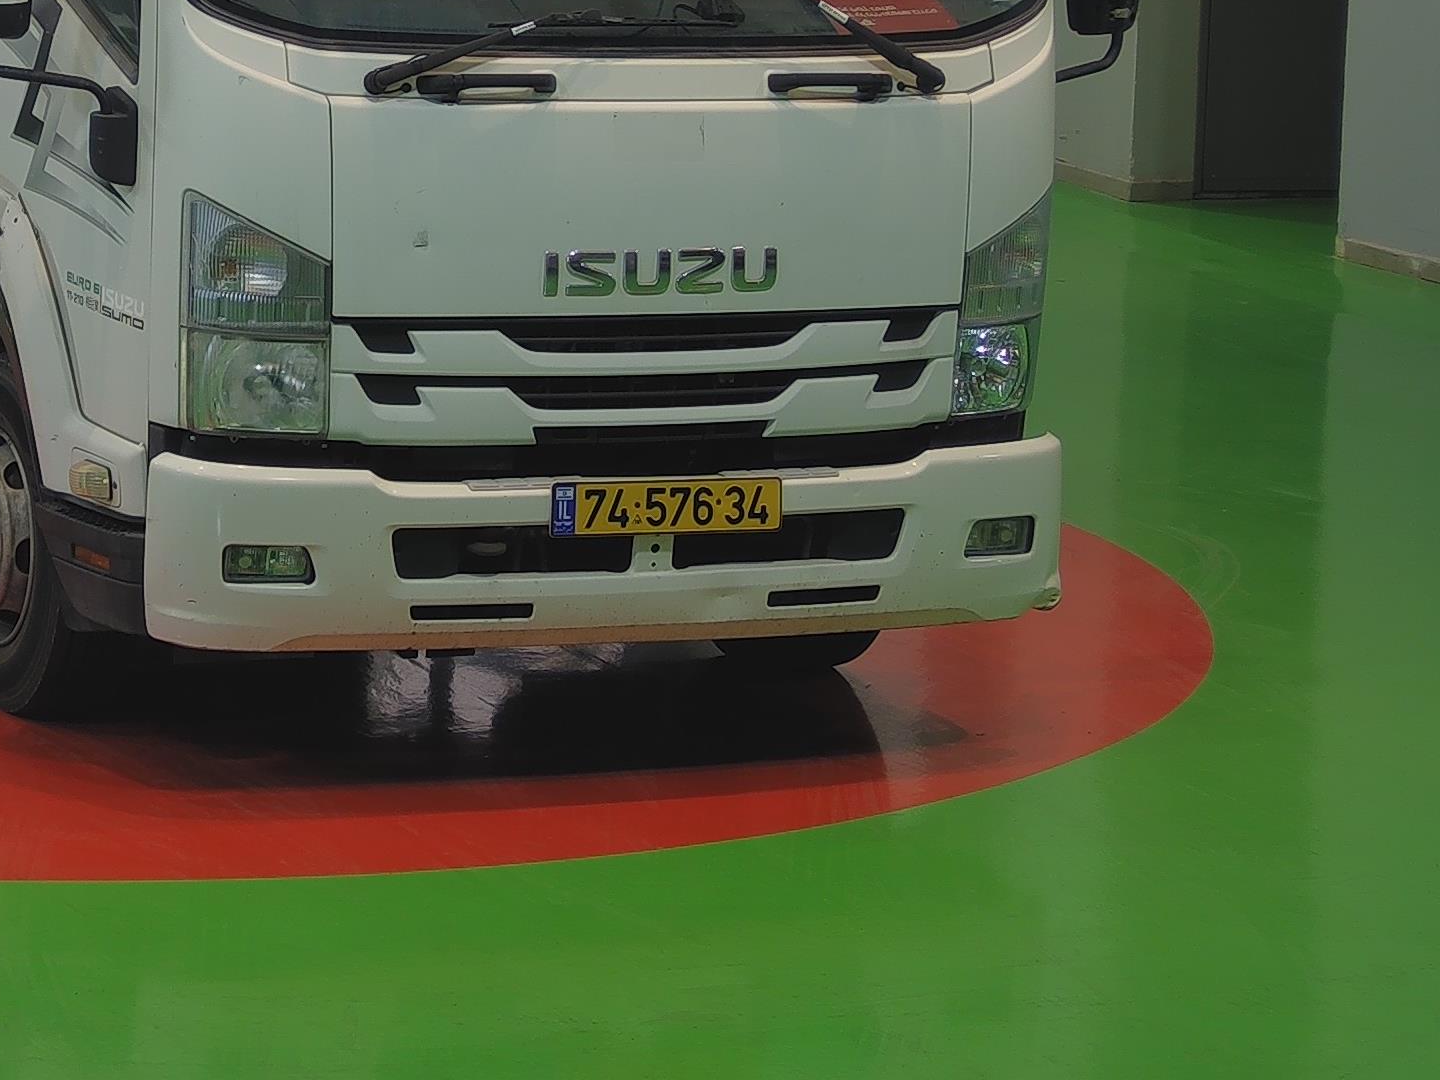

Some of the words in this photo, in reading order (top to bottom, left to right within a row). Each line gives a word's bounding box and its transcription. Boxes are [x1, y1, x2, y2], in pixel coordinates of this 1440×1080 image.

[66, 271, 91, 291] EURO
[543, 246, 778, 298] ISUZU
[101, 286, 144, 318] ISUZU
[559, 501, 571, 520] IL
